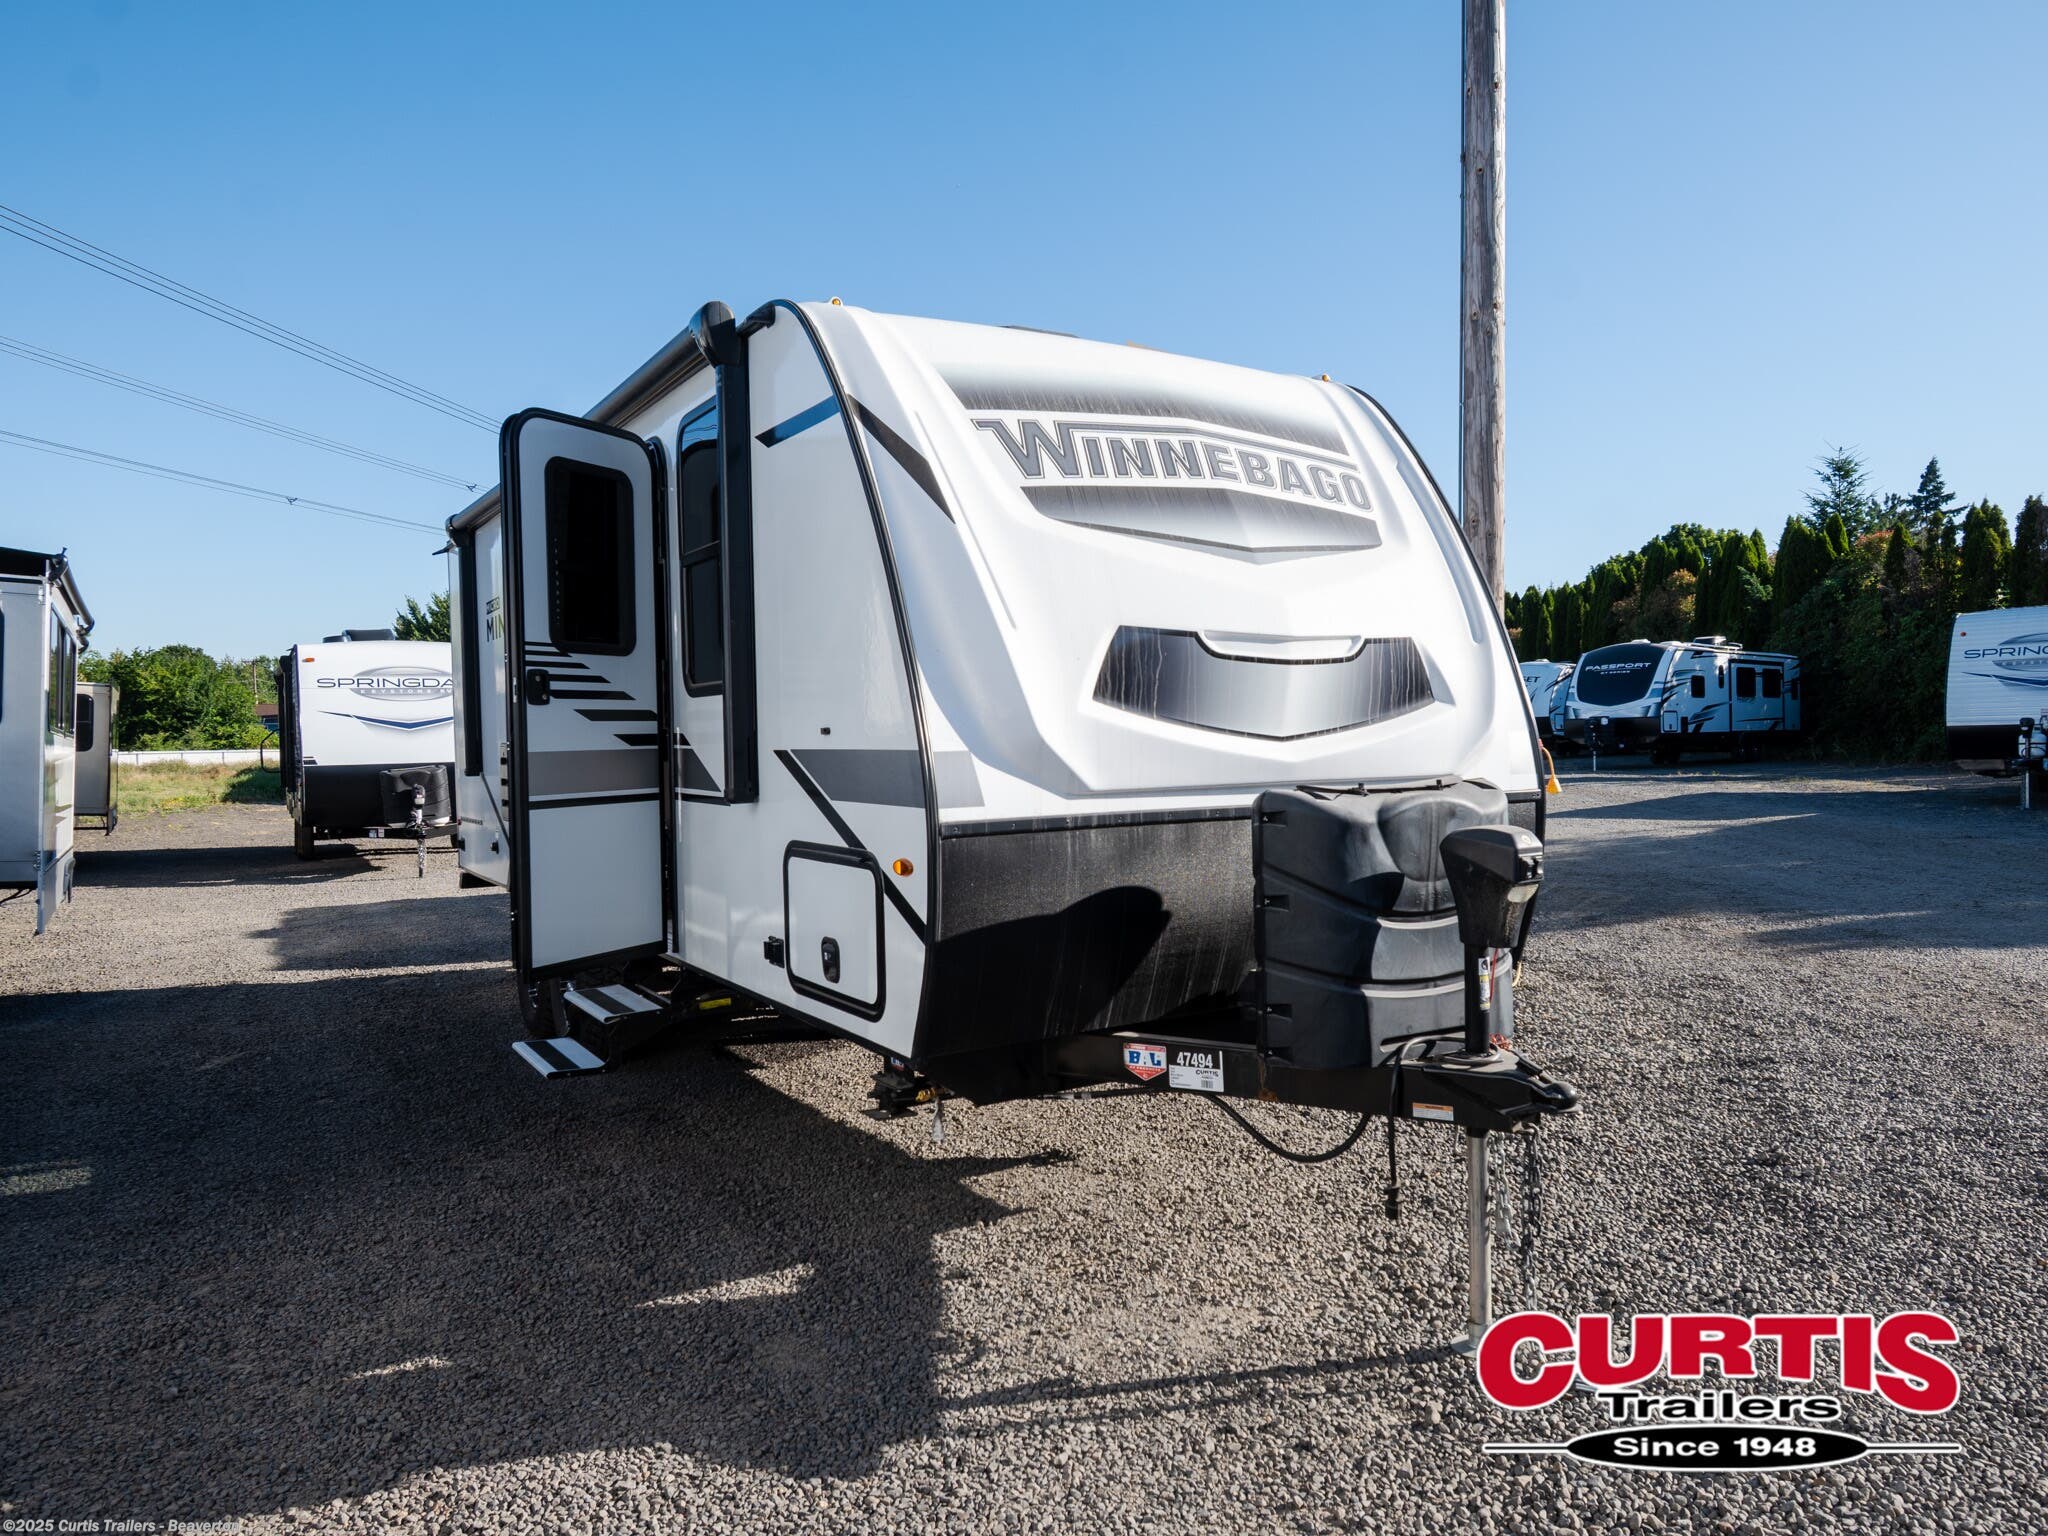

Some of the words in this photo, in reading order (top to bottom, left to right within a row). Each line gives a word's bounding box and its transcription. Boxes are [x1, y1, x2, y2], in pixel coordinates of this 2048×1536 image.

[970, 417, 1375, 513] WINNEBAGO
[1585, 663, 1651, 671] PASSPORT
[1177, 1052, 1213, 1068] 47494
[1195, 1068, 1219, 1077] CURTIS
